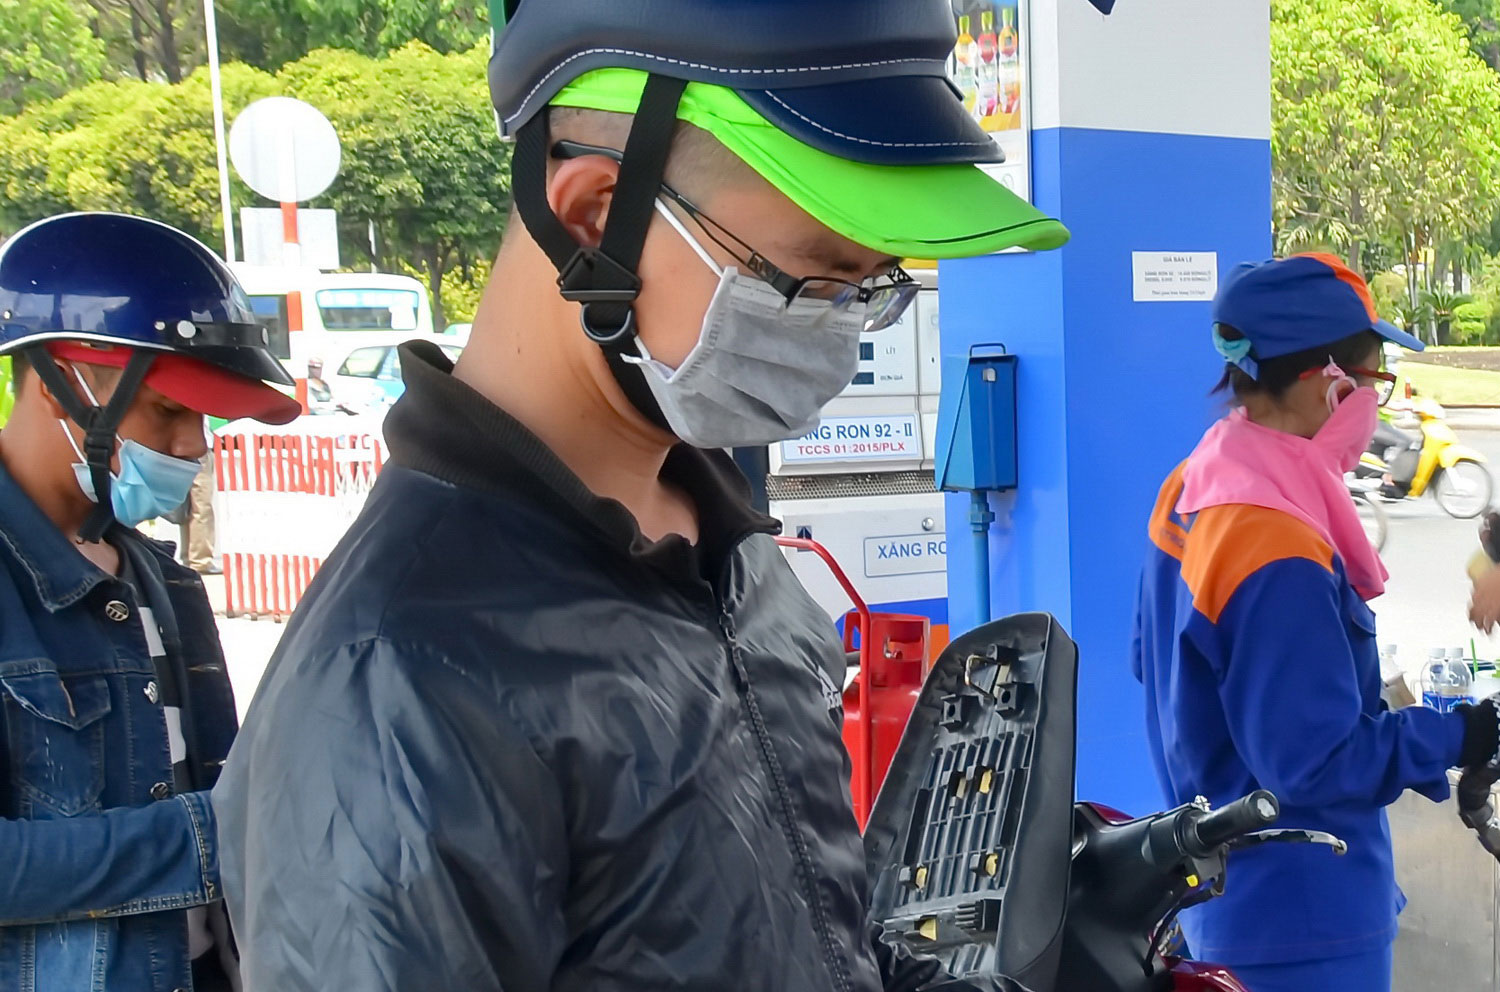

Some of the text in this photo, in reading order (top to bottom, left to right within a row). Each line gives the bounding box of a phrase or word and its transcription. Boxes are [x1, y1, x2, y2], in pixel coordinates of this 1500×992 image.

[799, 425, 831, 441] NG
[836, 424, 870, 440] RON
[875, 423, 892, 438] 92
[798, 444, 831, 455] TCCS
[878, 541, 946, 559] XĂNG RO
